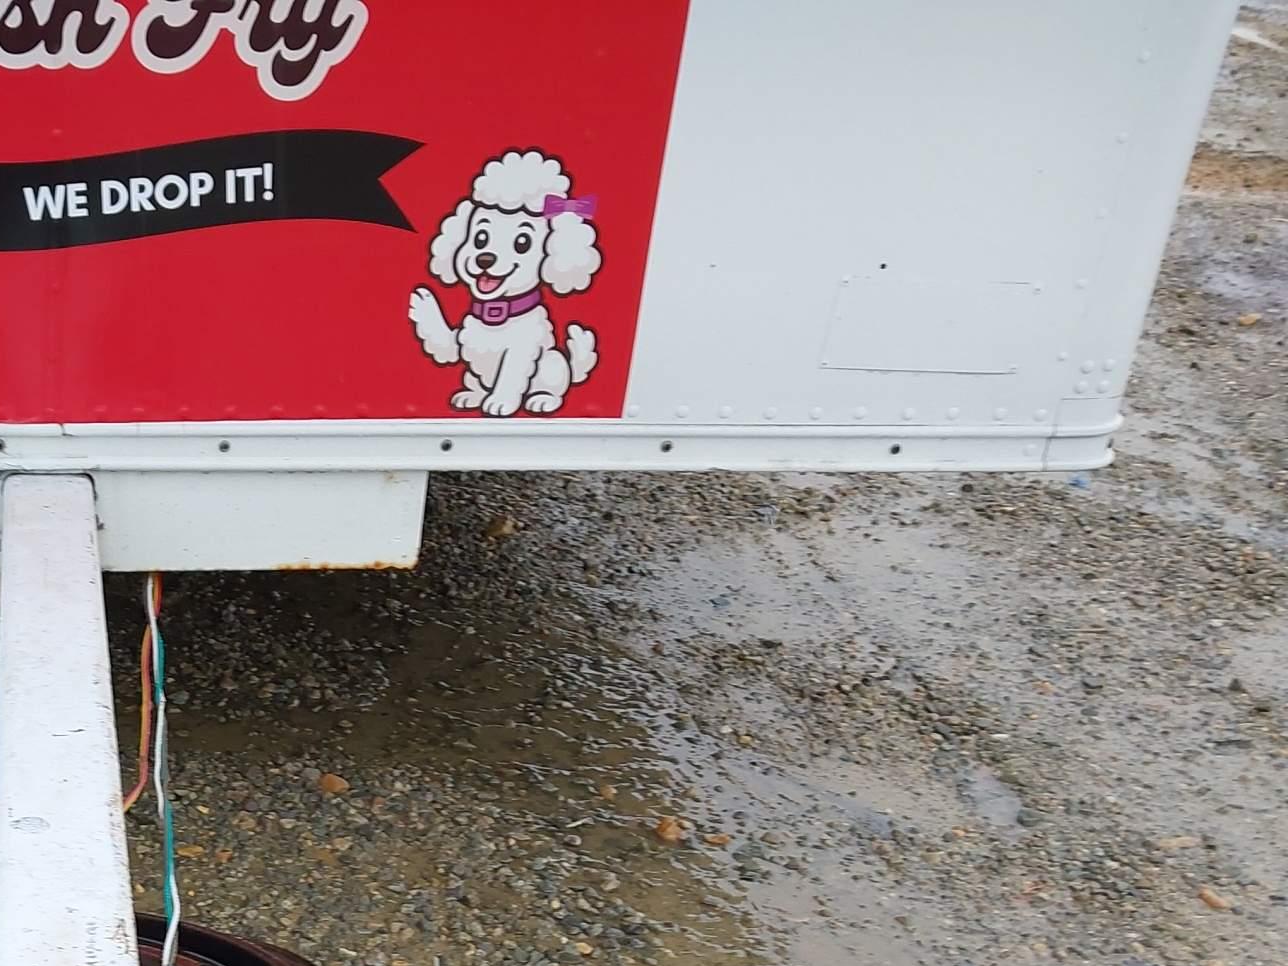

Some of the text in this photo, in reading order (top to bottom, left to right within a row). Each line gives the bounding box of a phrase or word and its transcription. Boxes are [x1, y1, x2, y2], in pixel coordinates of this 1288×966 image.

[23, 162, 274, 221] WE DROP IT!
